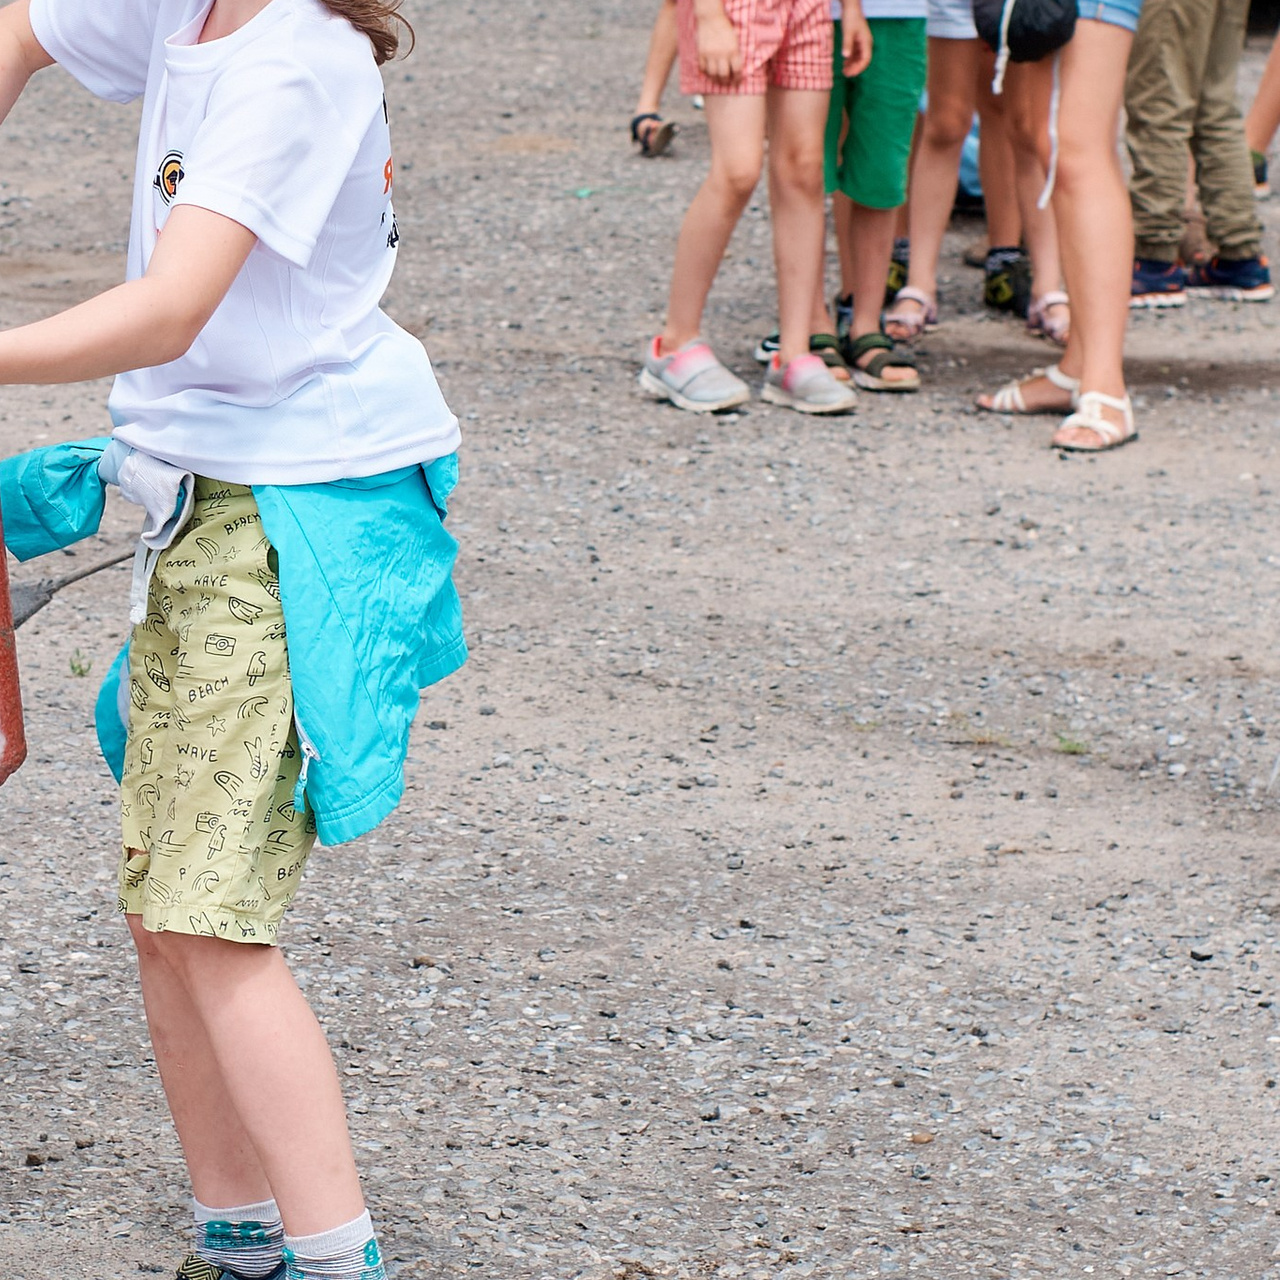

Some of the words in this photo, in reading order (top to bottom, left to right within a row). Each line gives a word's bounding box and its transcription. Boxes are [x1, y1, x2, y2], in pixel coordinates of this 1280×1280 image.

[224, 512, 262, 535] BEACH
[194, 574, 229, 587] WAVE
[188, 676, 229, 703] BEACH
[176, 743, 218, 762] WAVE
